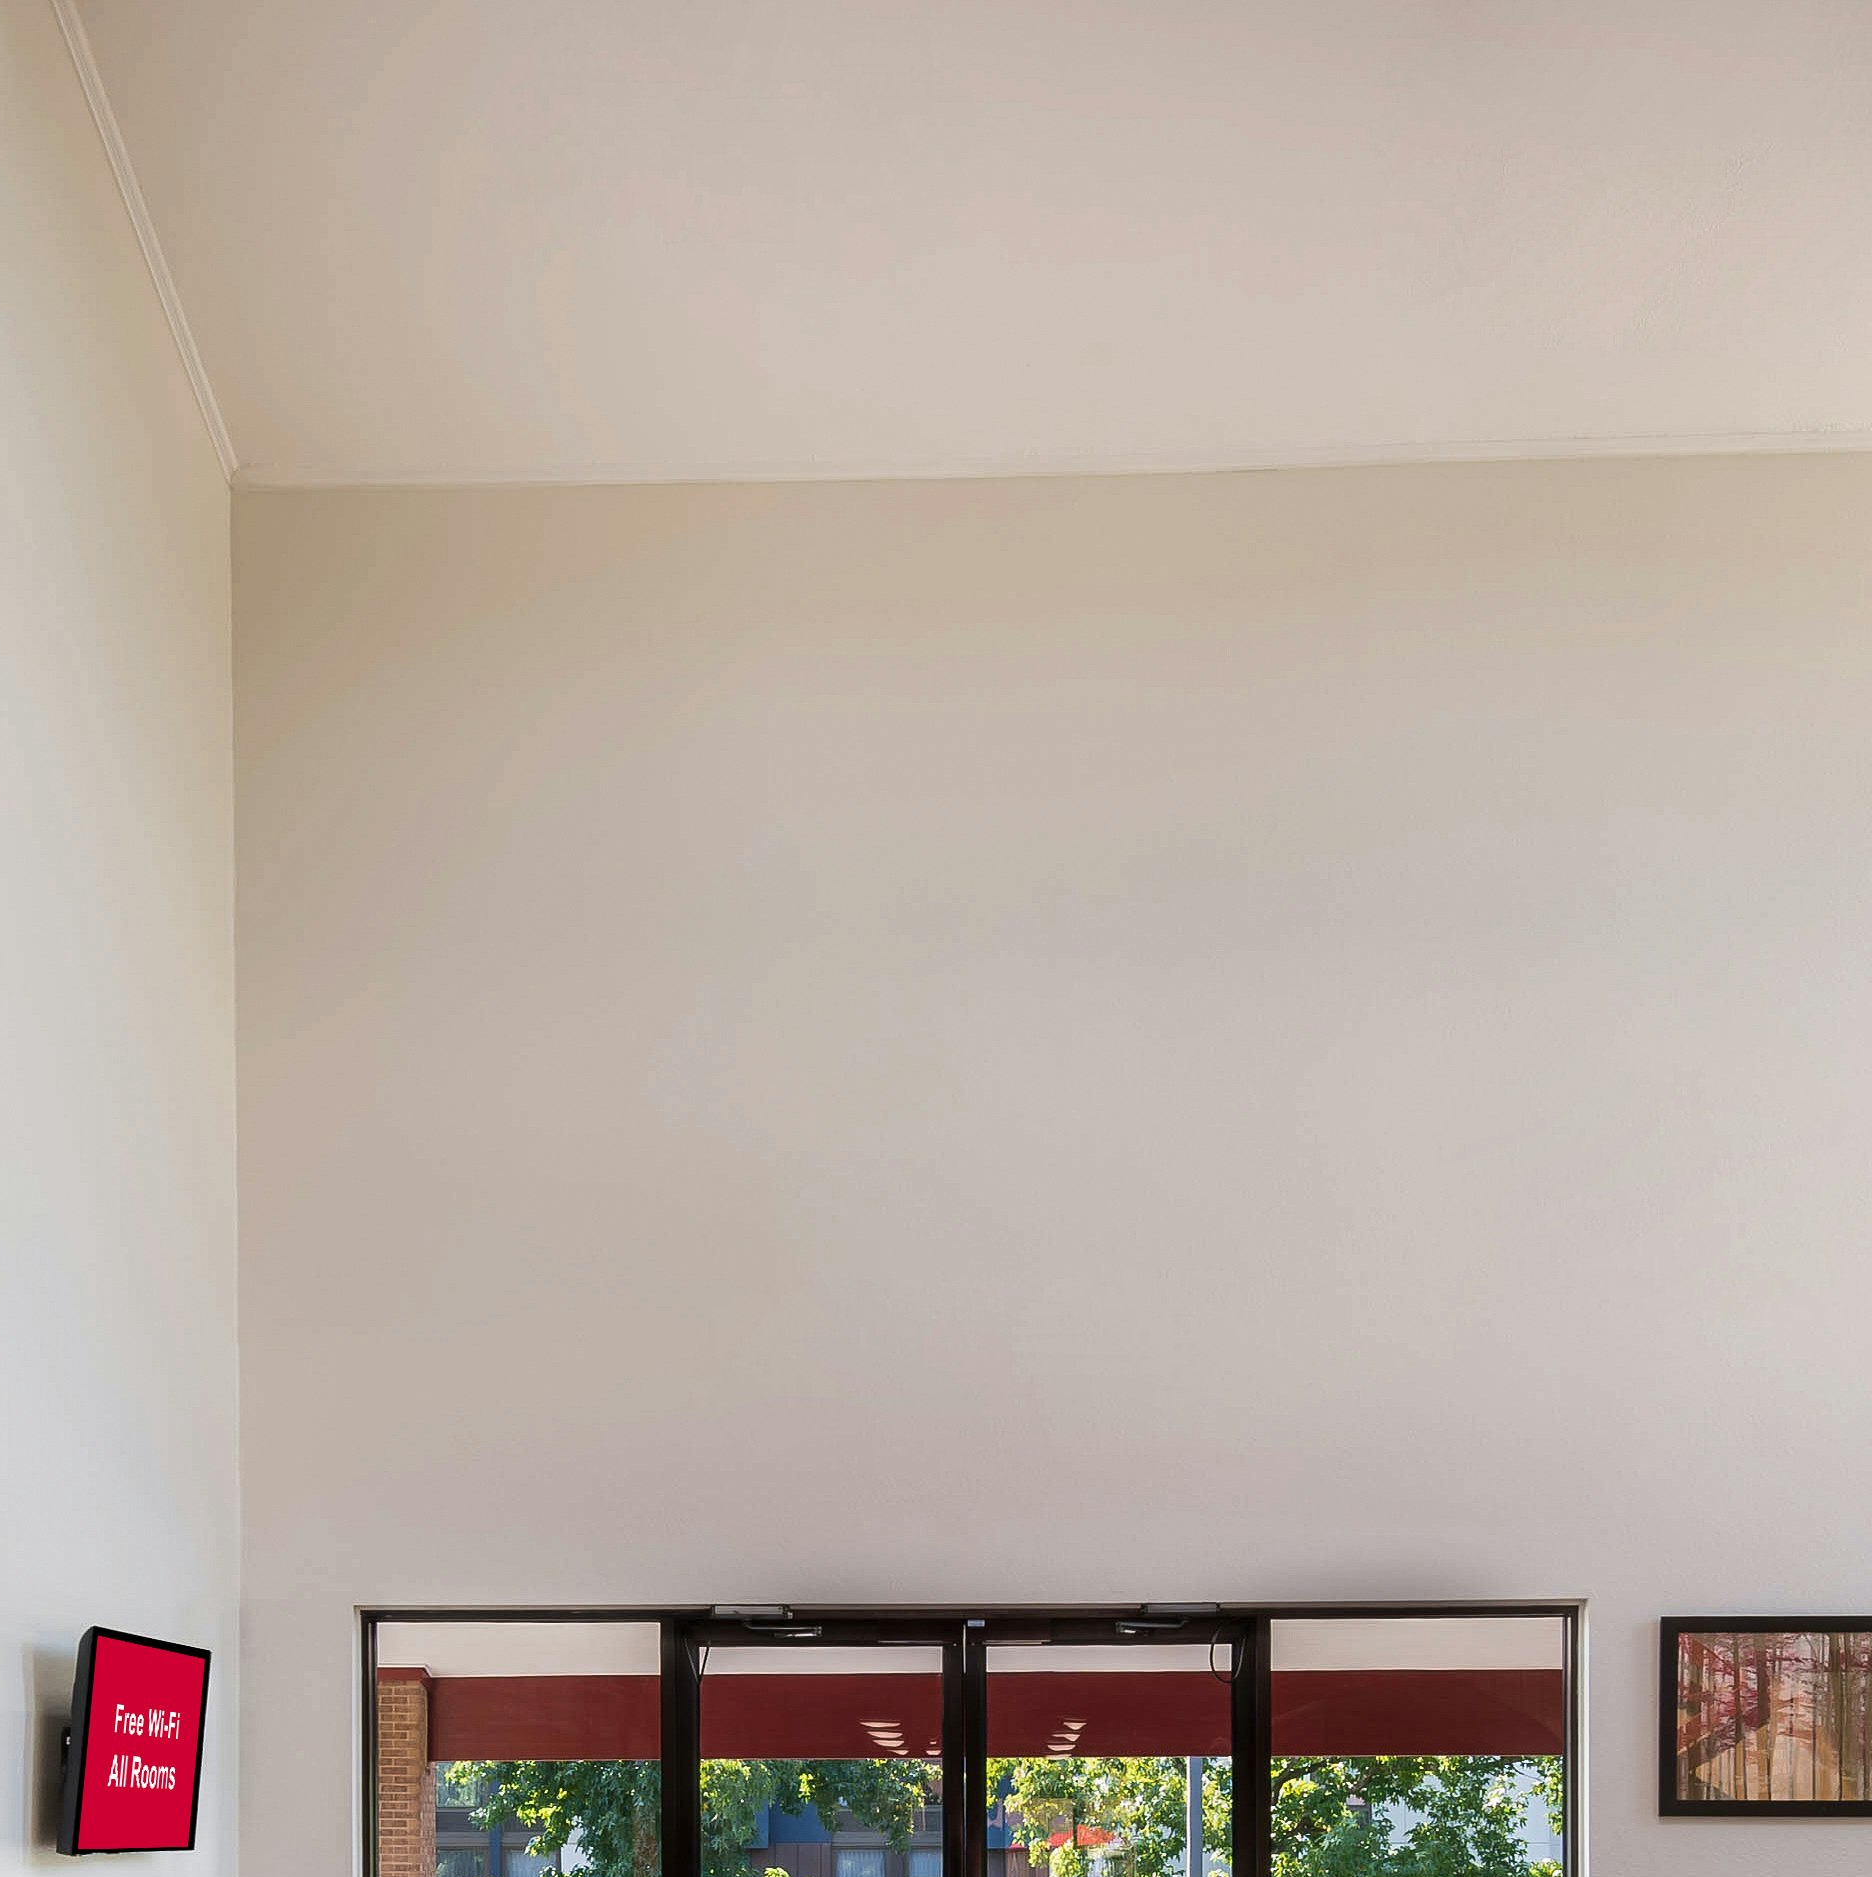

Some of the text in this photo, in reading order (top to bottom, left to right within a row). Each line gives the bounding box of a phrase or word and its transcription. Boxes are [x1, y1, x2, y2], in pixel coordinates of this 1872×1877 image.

[114, 1704, 181, 1740] Free Wi-Fi
[107, 1754, 176, 1791] All Rooms
